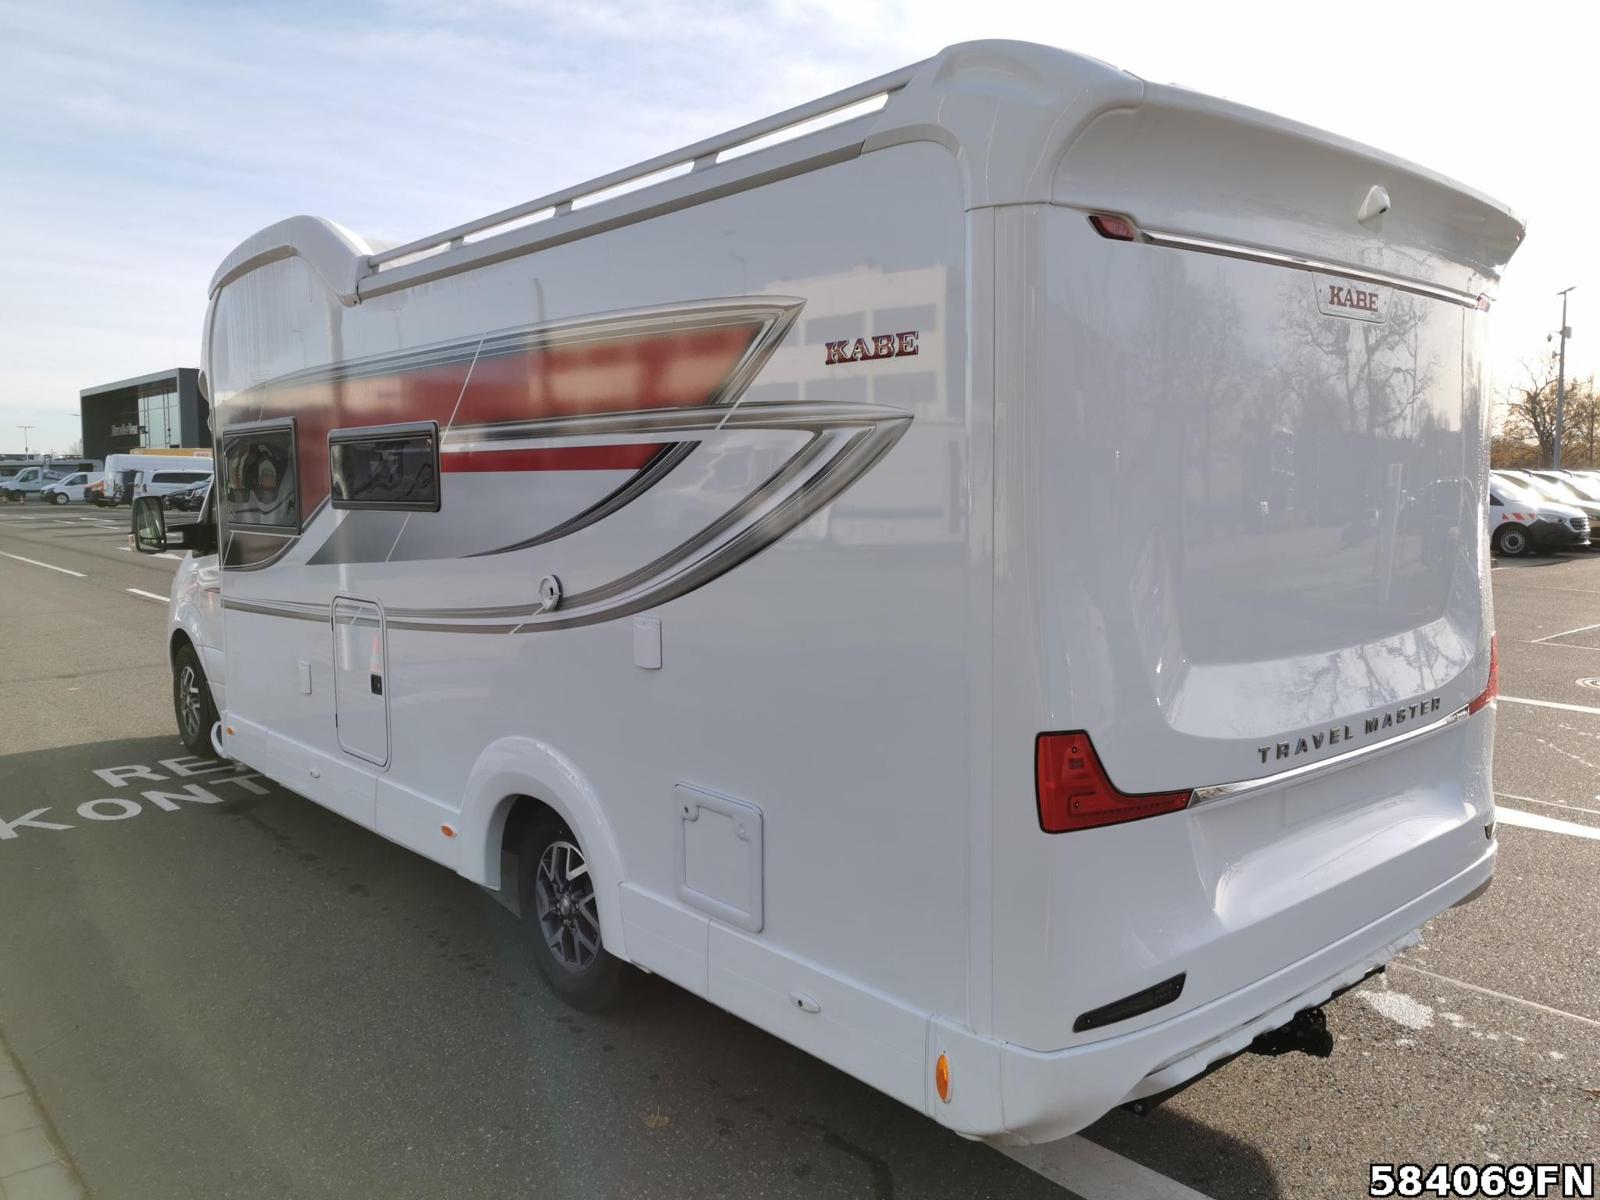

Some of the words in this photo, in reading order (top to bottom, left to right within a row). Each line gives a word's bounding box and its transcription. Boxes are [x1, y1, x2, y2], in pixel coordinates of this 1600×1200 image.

[1328, 285, 1378, 312] KABE
[825, 330, 919, 365] KABE
[1257, 723, 1354, 763] TRAVEL
[1364, 696, 1441, 734] MASTER
